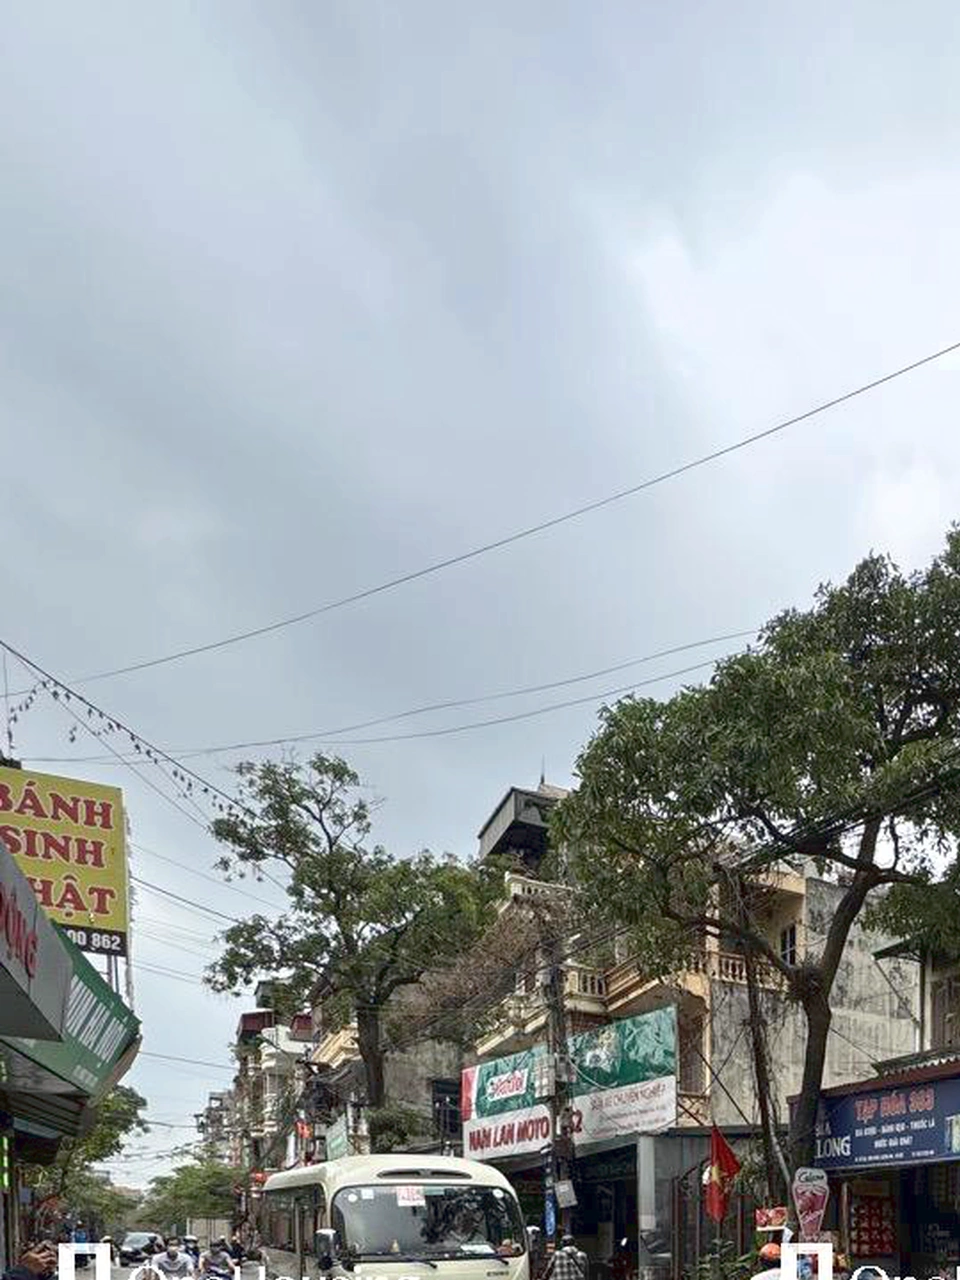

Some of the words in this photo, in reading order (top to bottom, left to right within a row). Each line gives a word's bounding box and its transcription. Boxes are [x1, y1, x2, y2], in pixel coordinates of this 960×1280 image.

[0, 780, 114, 830] BÁNH
[0, 825, 105, 868] SINH
[28, 875, 116, 918] HẬT
[91, 932, 121, 951] 862
[517, 1115, 550, 1143] MOTO
